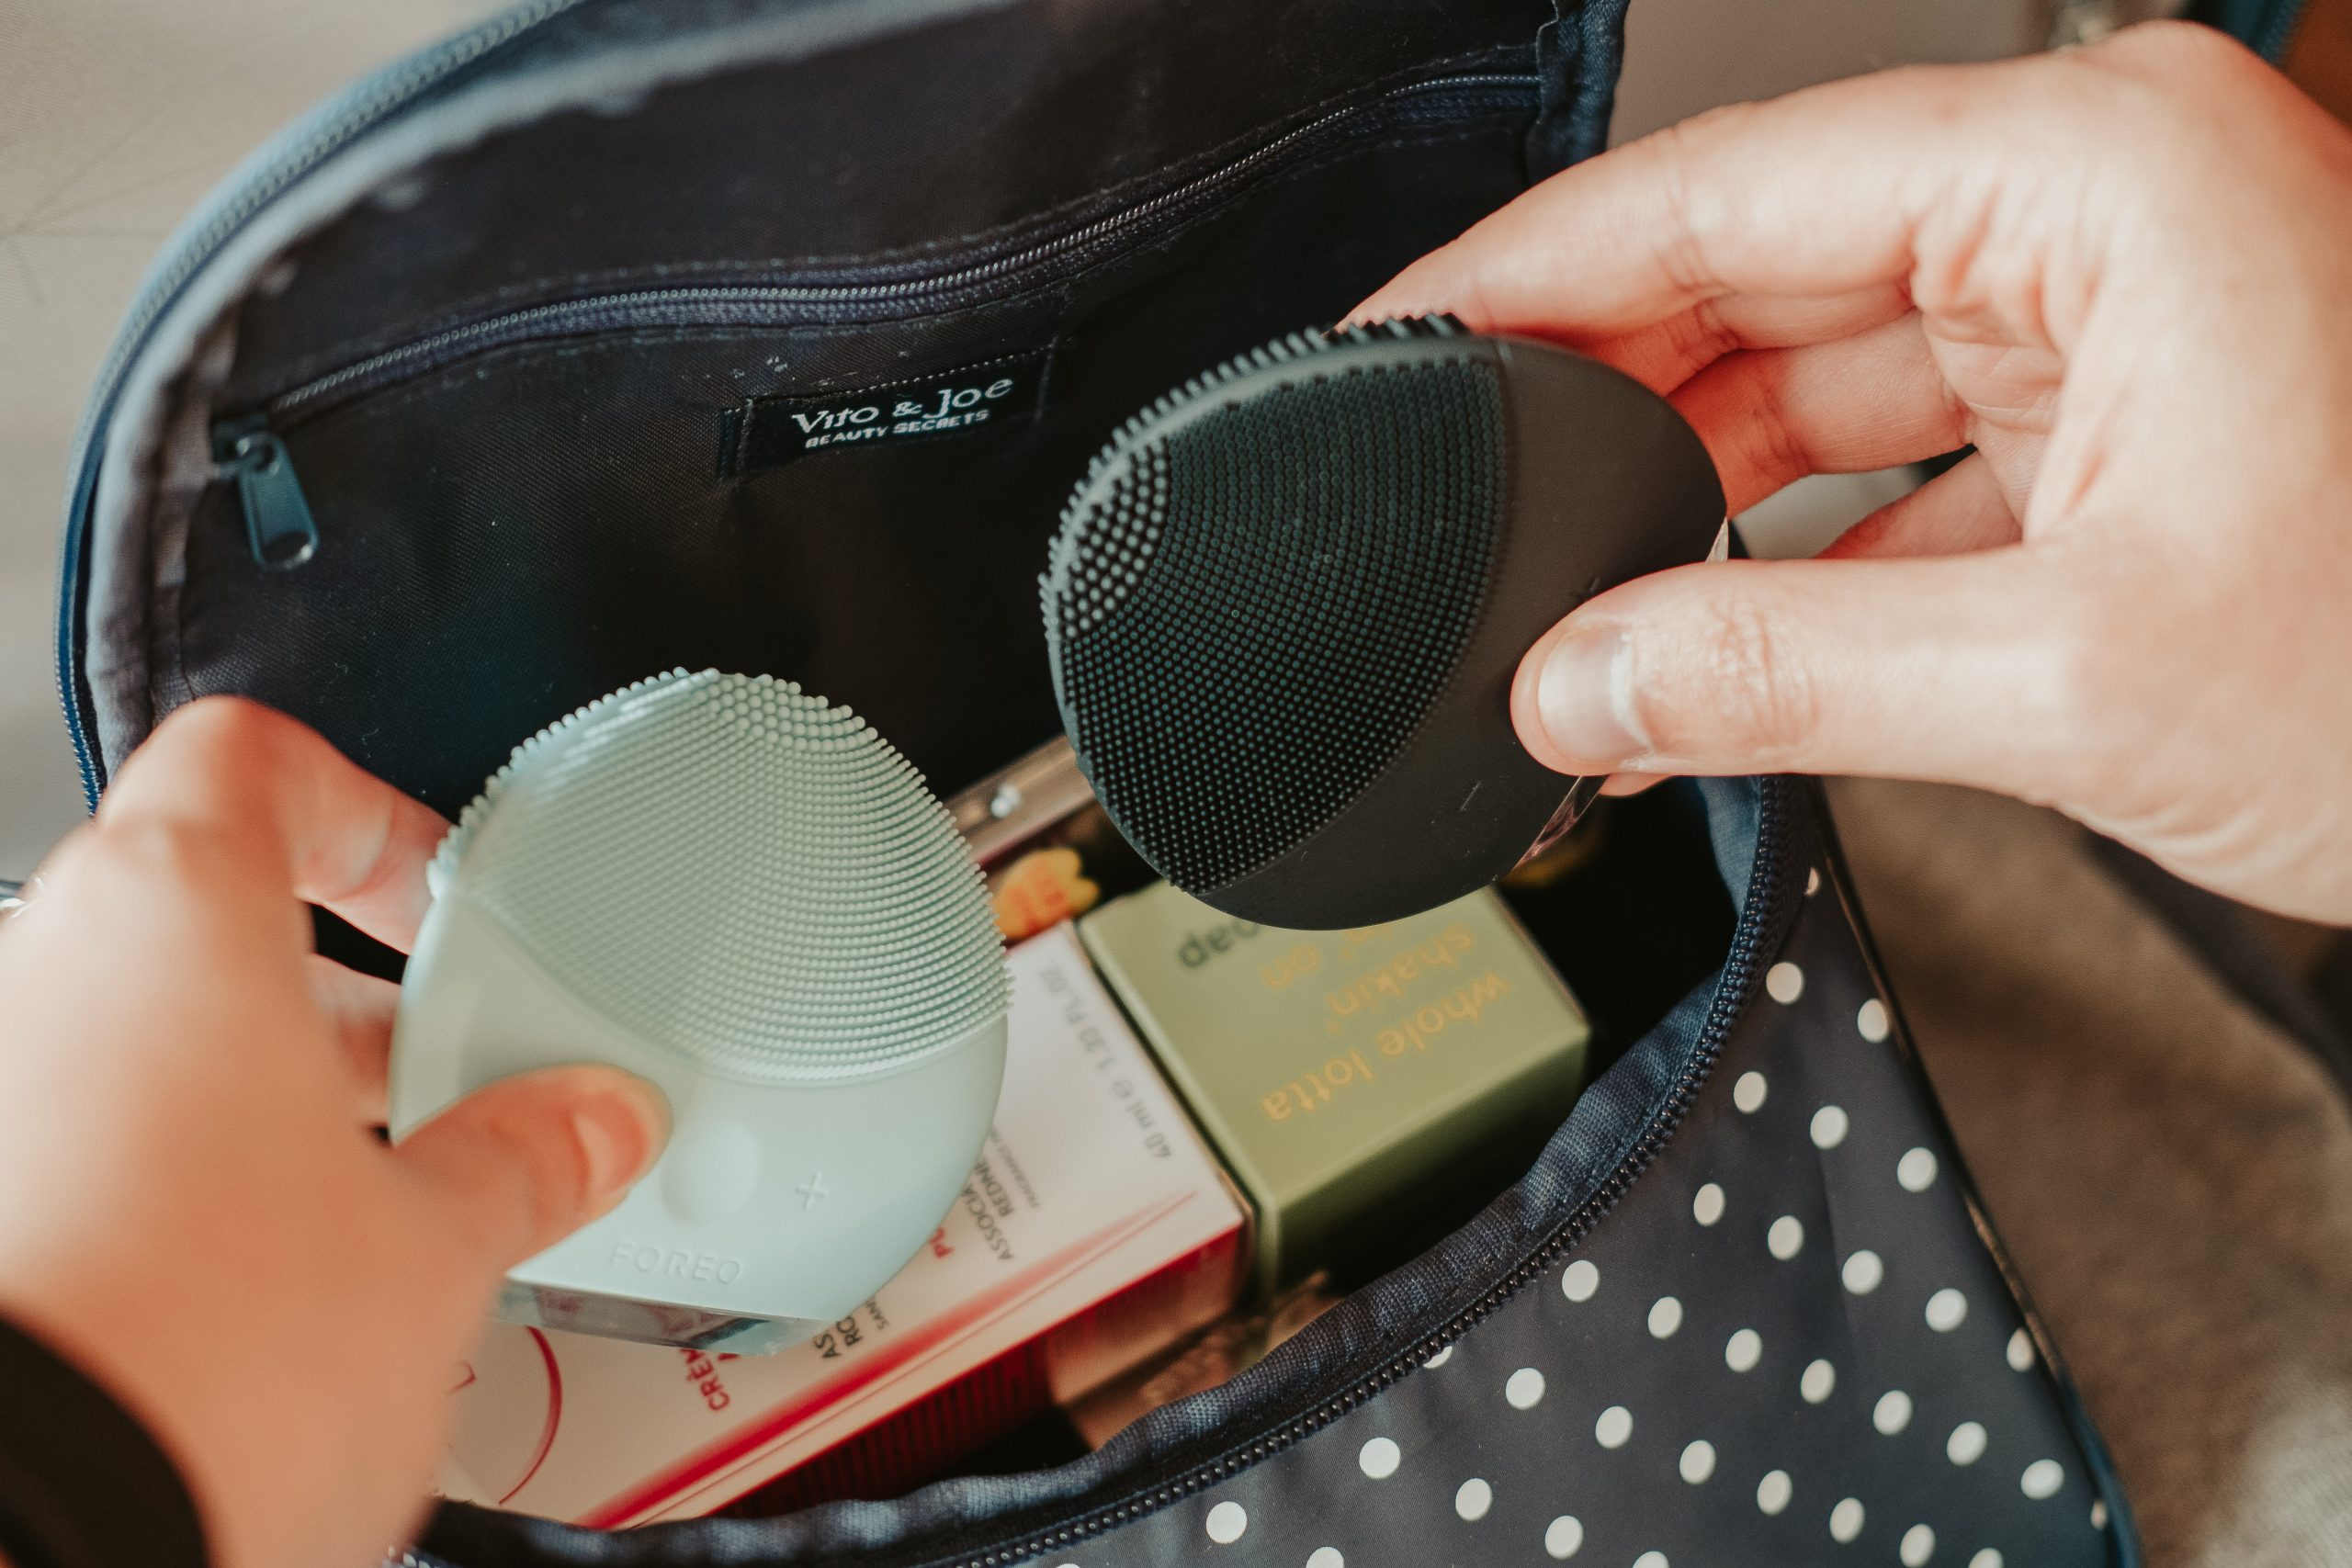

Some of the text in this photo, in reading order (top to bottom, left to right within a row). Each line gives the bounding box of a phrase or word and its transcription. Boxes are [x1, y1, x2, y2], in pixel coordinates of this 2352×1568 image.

[791, 378, 1014, 434] Vito & Joe
[805, 409, 989, 448] BEAUTY SECRETS
[1261, 969, 1510, 1121] whole lotta
[1144, 1132, 1172, 1159] 40
[609, 1241, 742, 1284] FOREO
